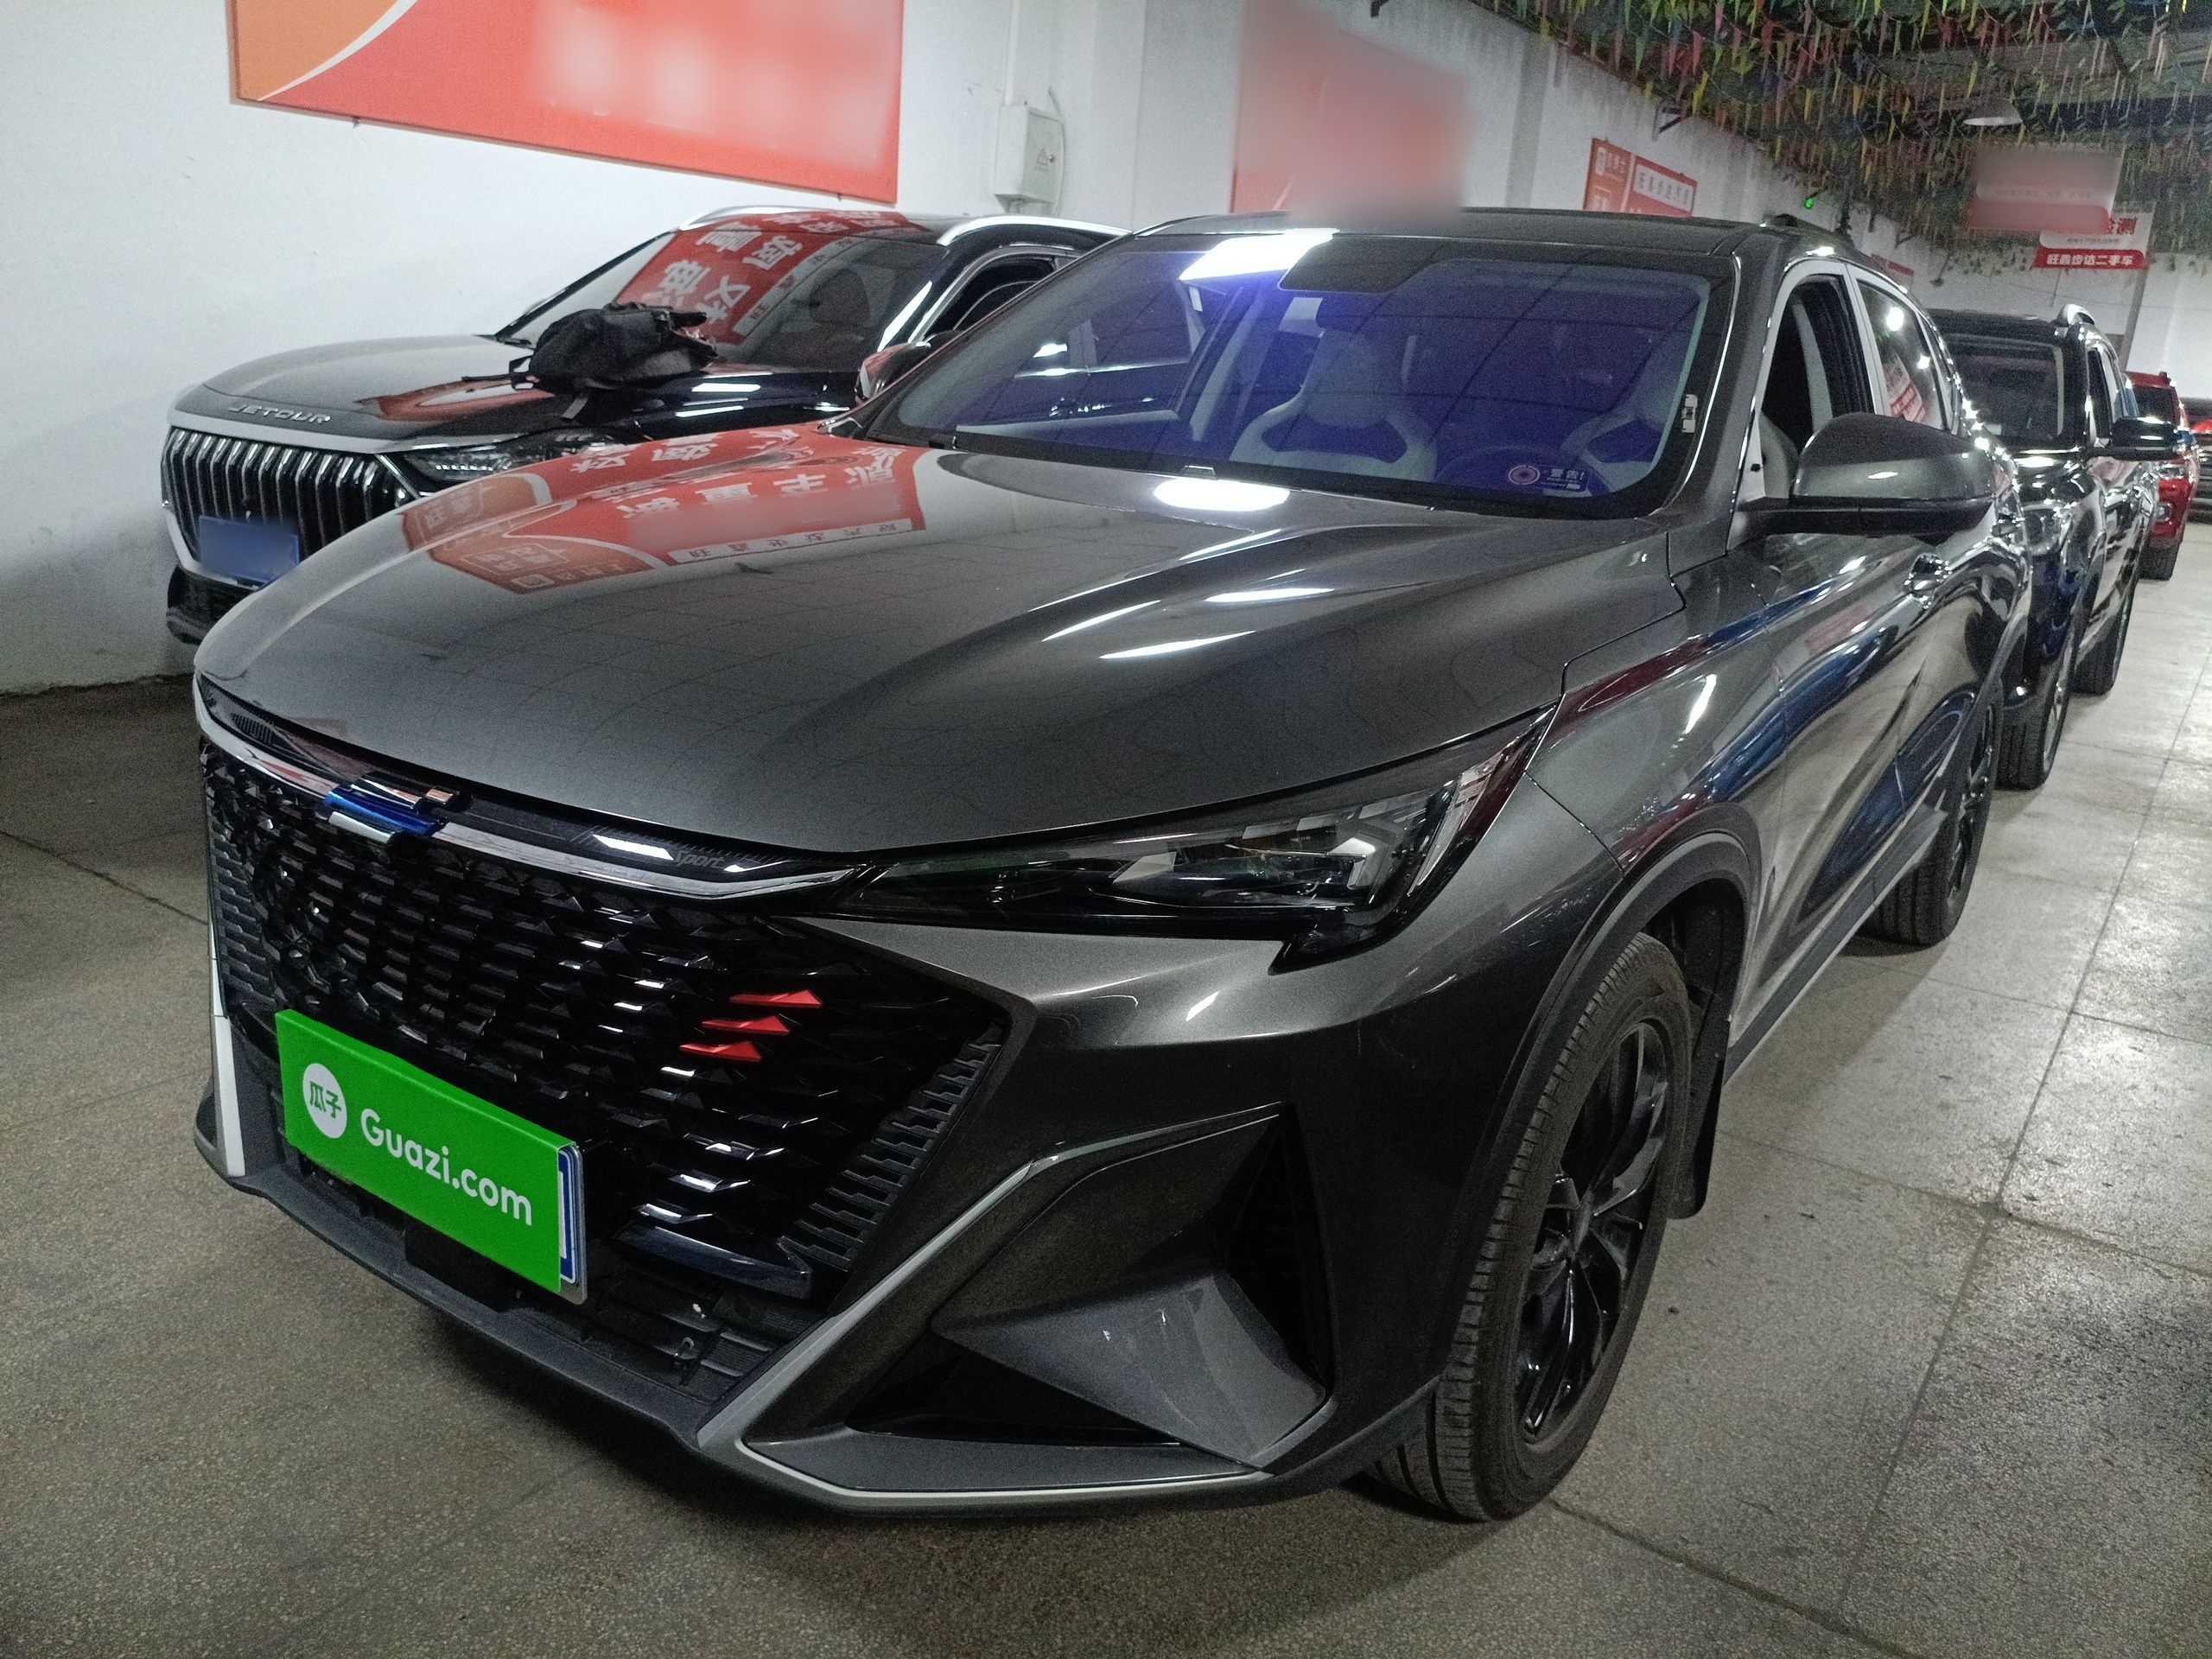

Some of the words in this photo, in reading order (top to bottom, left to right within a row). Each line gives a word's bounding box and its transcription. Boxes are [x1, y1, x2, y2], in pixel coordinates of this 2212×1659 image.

[227, 404, 331, 423] JETOUR
[309, 1081, 342, 1118] 瓜子
[360, 1108, 532, 1226] Guazi.com
